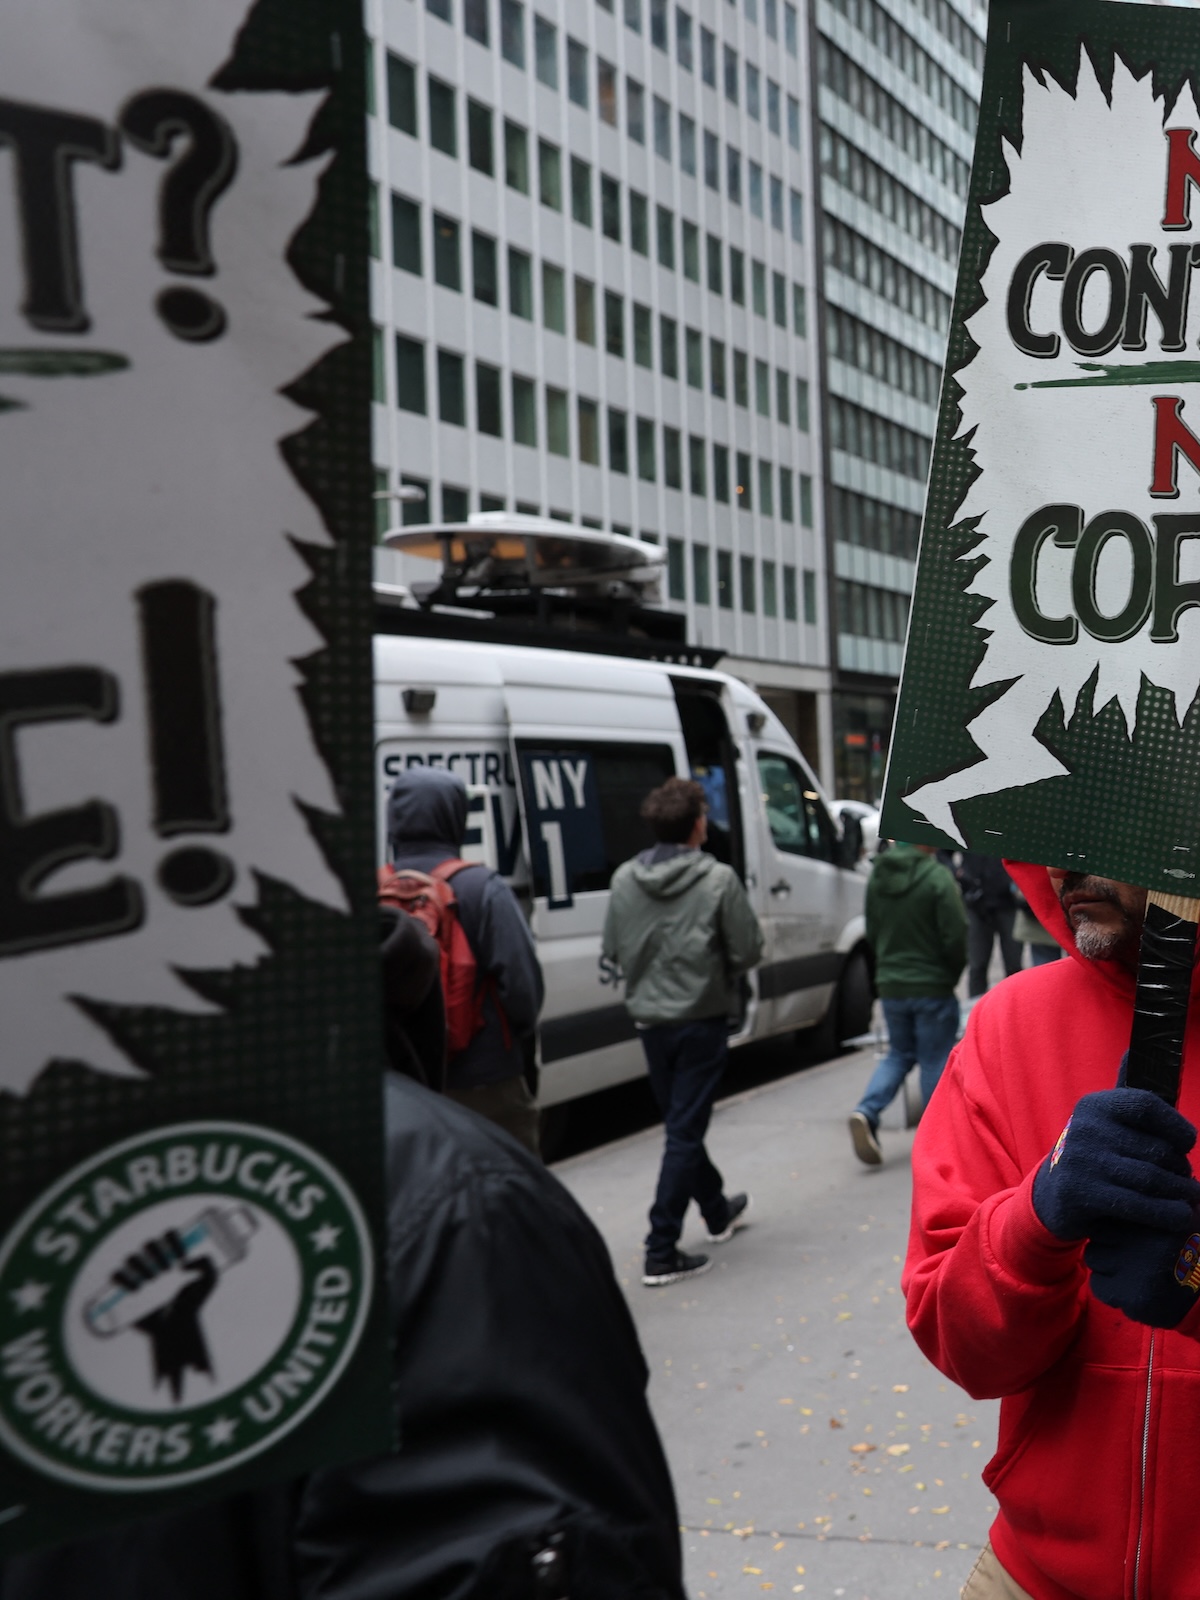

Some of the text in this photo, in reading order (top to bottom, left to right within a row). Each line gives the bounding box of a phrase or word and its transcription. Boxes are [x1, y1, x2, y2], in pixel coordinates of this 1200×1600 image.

[531, 760, 588, 810] NY
[541, 820, 568, 902] 1
[33, 1143, 327, 1262] STARBUCKS
[1, 1328, 192, 1466] WORKERS
[244, 1266, 351, 1423] UNITED
